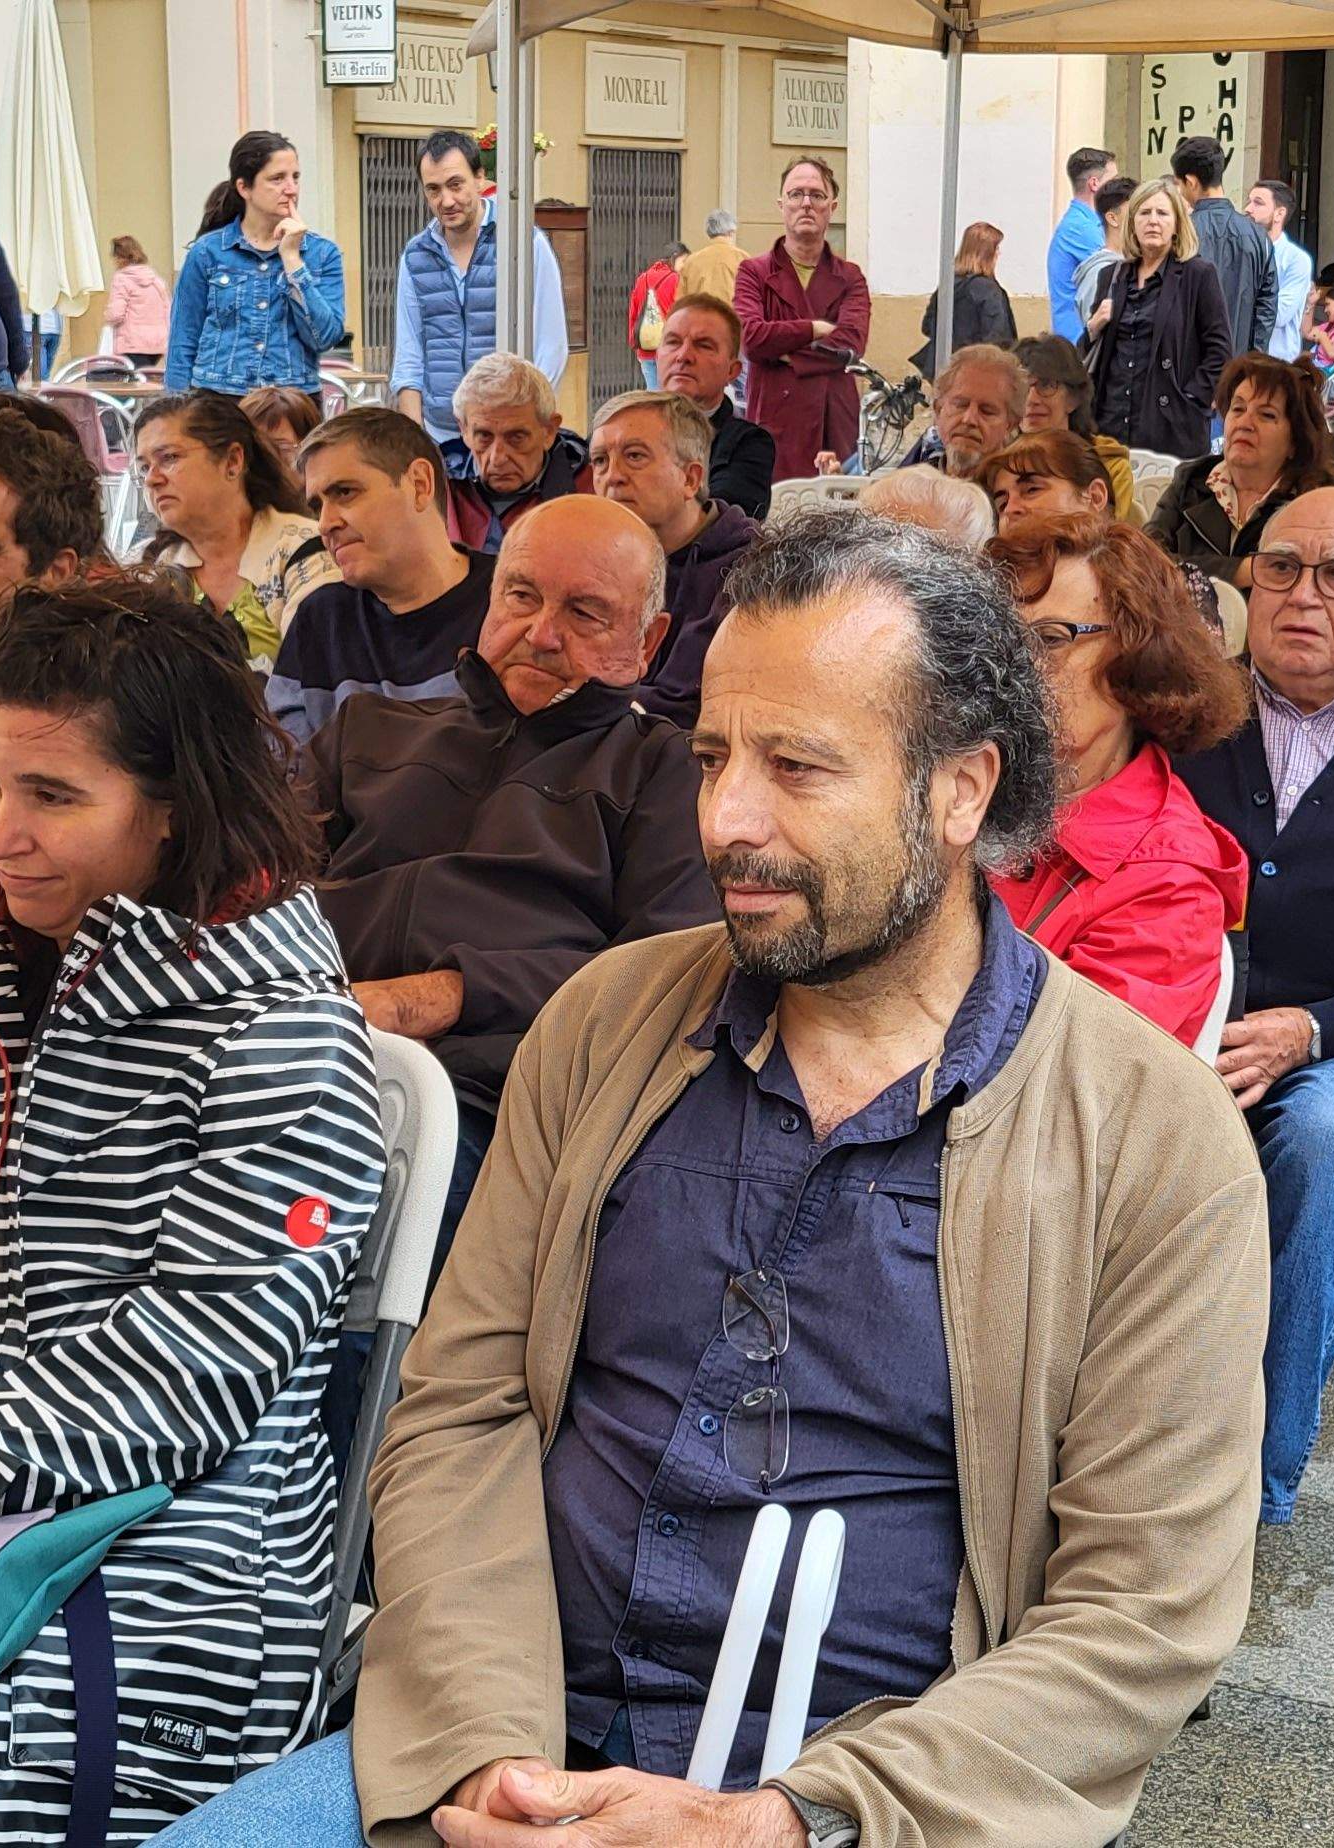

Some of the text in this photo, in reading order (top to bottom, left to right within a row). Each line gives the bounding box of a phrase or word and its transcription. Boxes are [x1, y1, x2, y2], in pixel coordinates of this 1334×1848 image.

[332, 5, 382, 21] VELTINS
[331, 60, 388, 77] Alt Berlin
[415, 77, 456, 106] JUAN
[604, 75, 668, 106] MONREAL
[782, 77, 846, 105] ALMACENES
[787, 105, 841, 131] SAN JUAN
[153, 1716, 195, 1737] WE ARE
[158, 1731, 192, 1748] ALIFE
